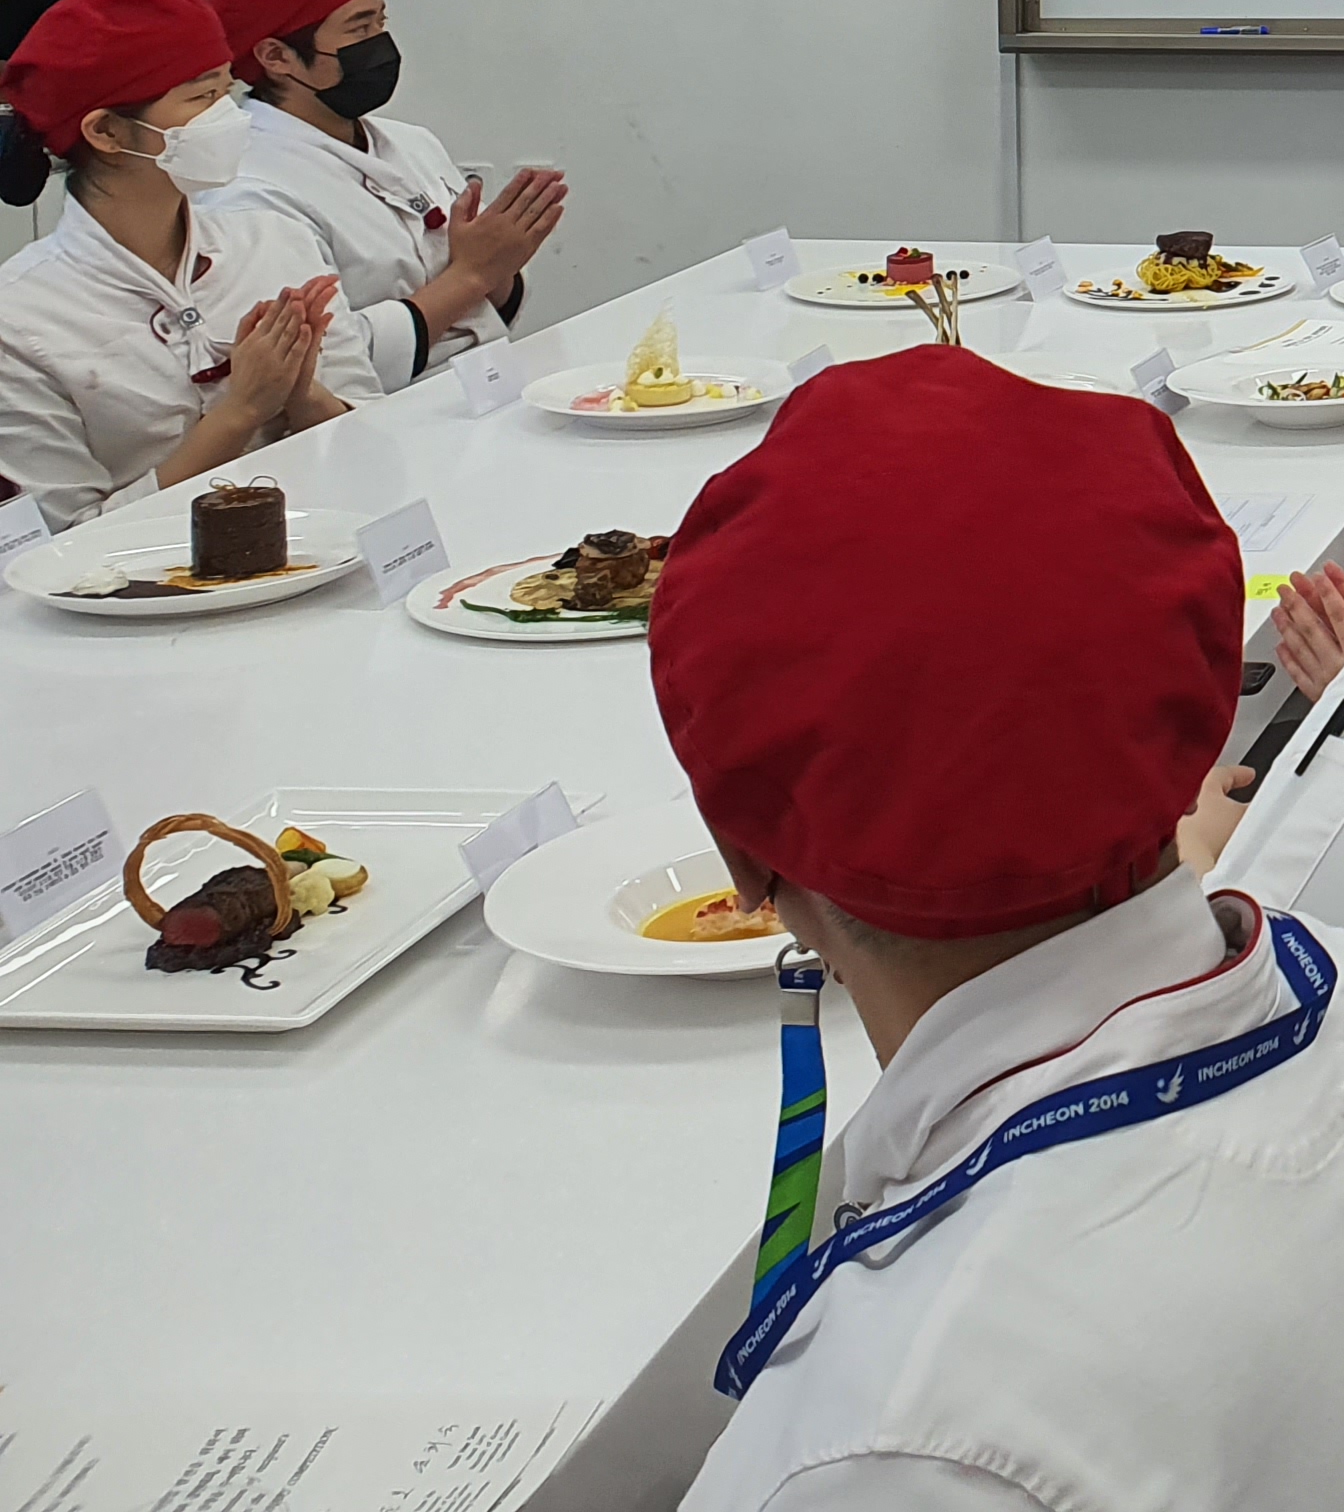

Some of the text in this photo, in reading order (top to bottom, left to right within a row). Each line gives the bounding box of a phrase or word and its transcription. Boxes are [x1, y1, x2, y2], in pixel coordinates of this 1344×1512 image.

[1281, 932, 1325, 990] INCHEON
[1198, 1036, 1280, 1083] INCHEON 2014
[1002, 1091, 1130, 1144] INCHEON 2014
[843, 1181, 947, 1246] INCHEON 2014
[737, 1283, 797, 1366] INCHEON 2014
